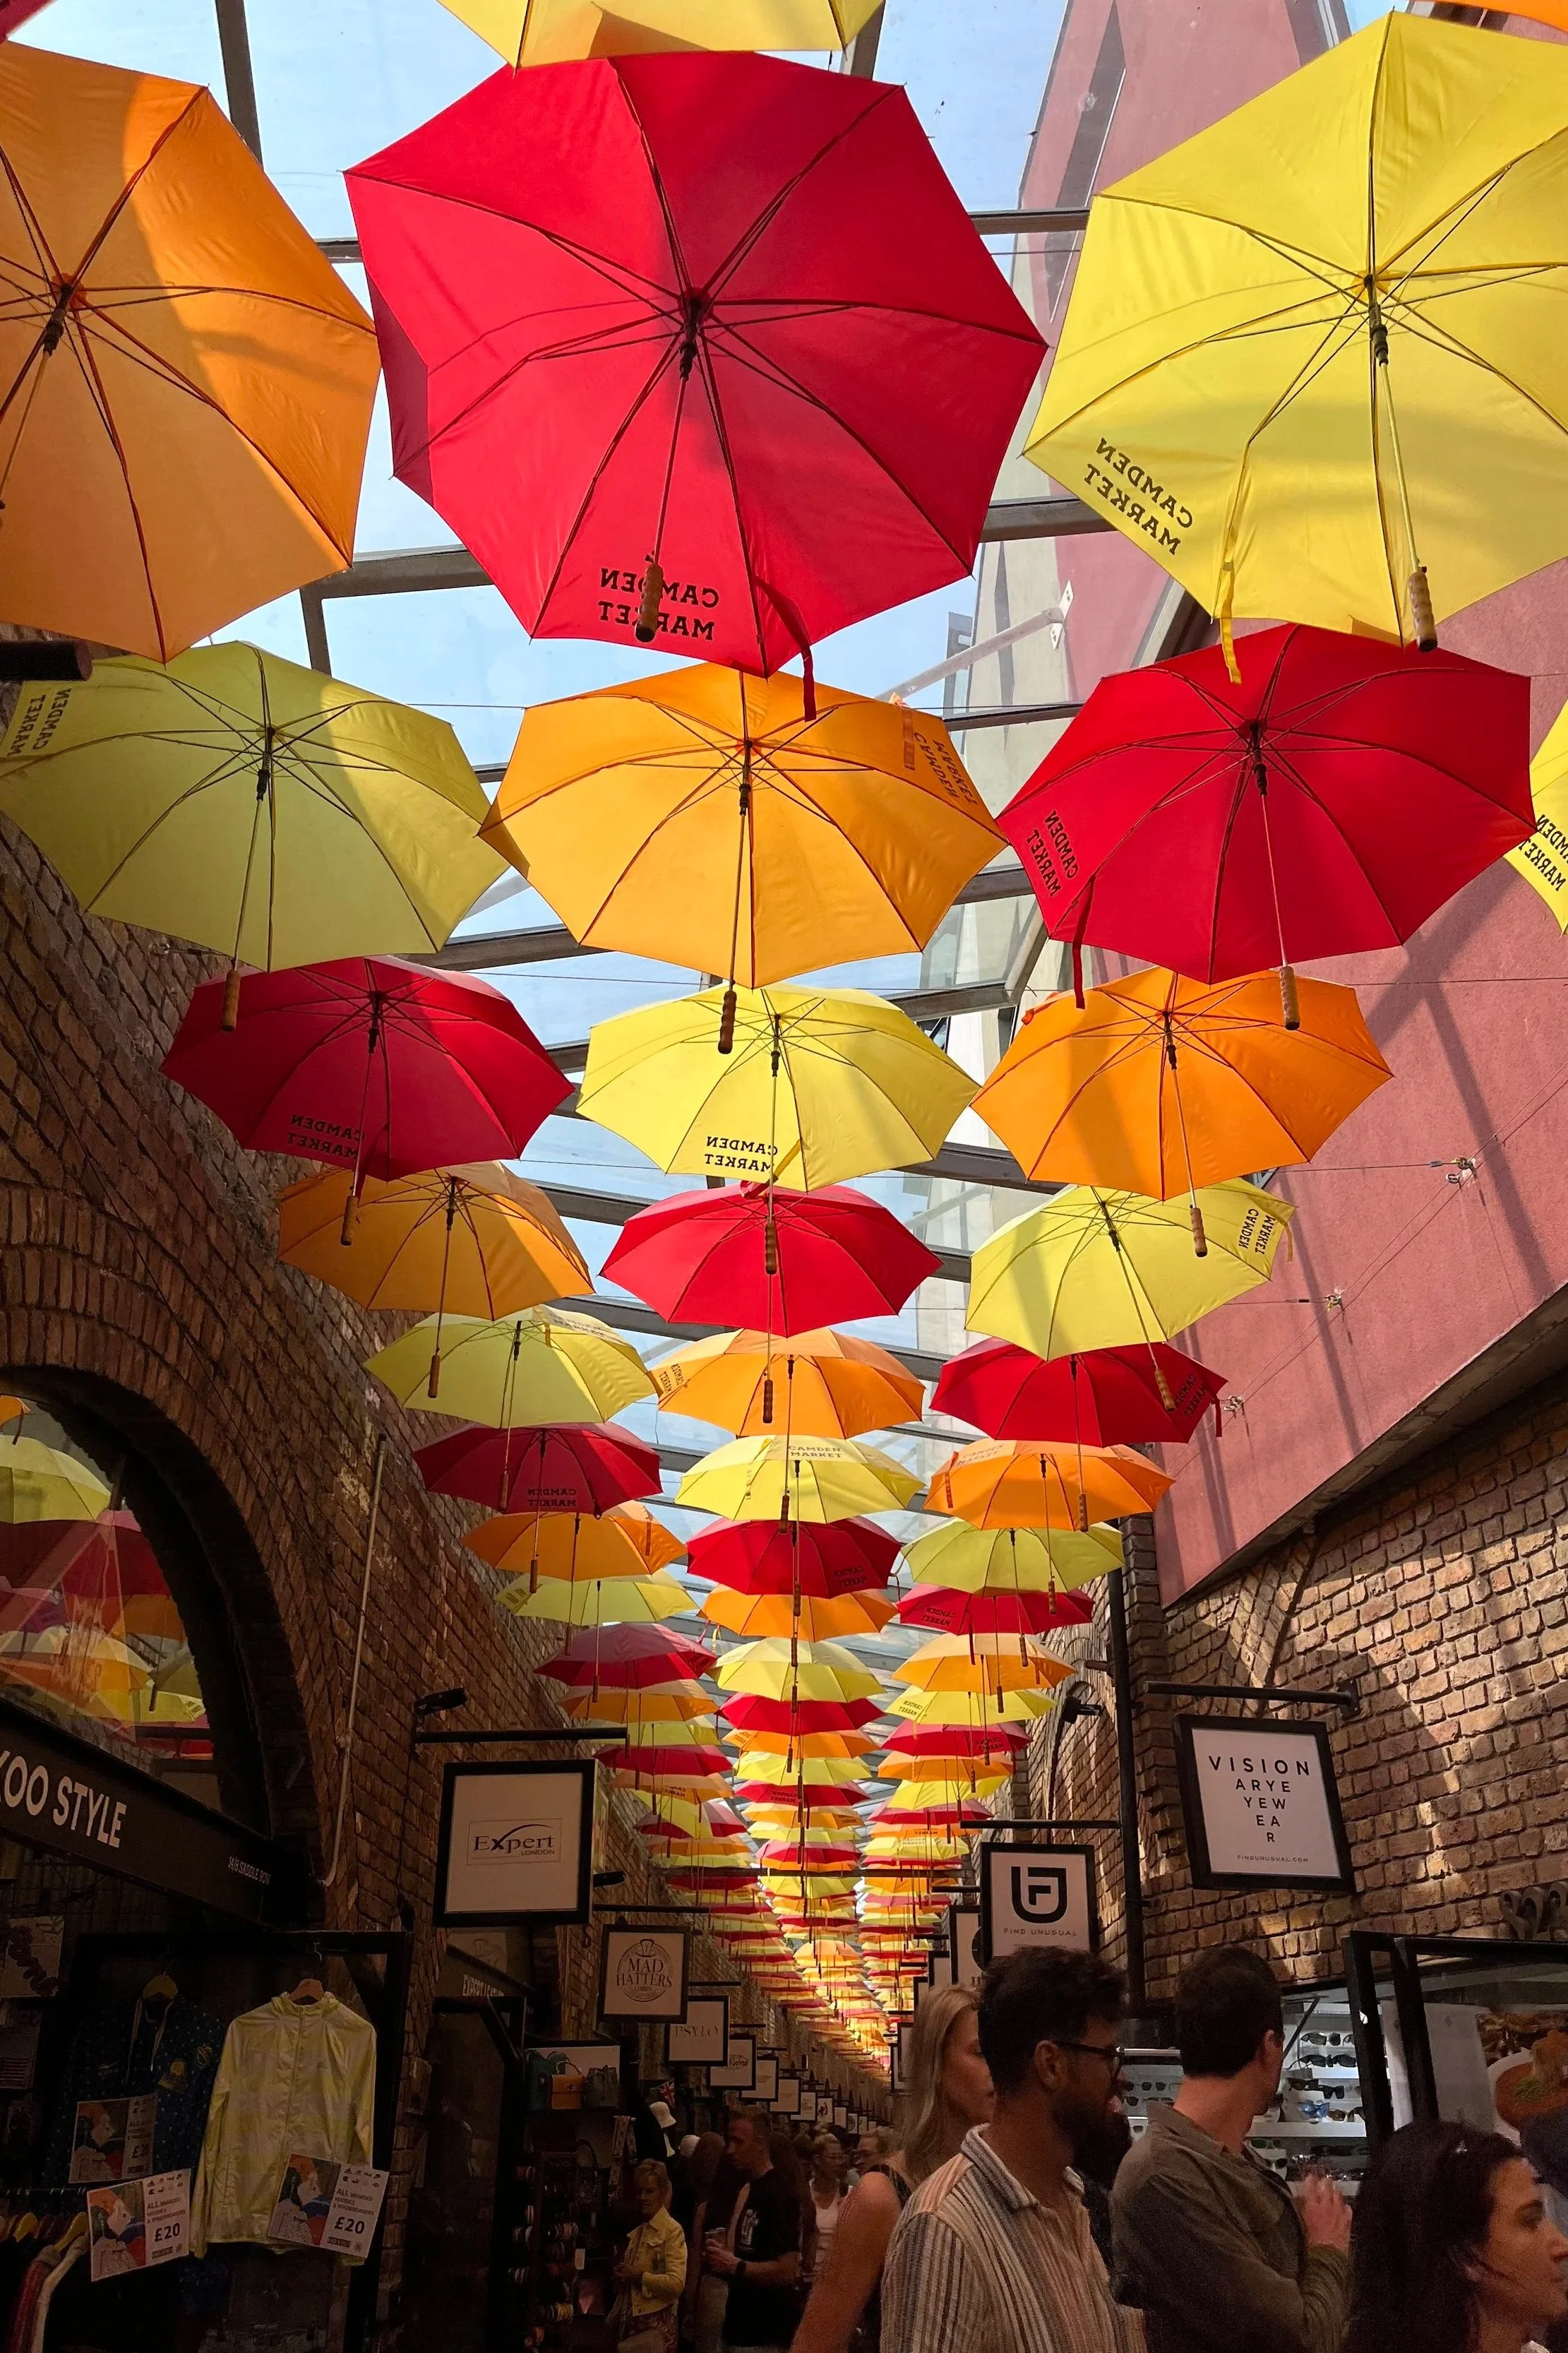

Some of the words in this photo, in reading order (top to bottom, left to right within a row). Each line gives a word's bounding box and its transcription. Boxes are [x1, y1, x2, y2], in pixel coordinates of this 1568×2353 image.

[1209, 1756, 1310, 1775] VISION
[1235, 1779, 1291, 1792] ARYE
[1243, 1797, 1286, 1809] YEW
[53, 1775, 127, 1848] STYLE
[1256, 1815, 1281, 1827] EA
[474, 1832, 555, 1854] Expert
[1267, 1832, 1275, 1842] R
[628, 1958, 664, 1972] MAD
[616, 1972, 672, 1989] HATTERS
[676, 2025, 719, 2037] PSYLO
[148, 2200, 160, 2209] ALL
[155, 2223, 180, 2242] £20
[334, 2217, 365, 2234] £20
